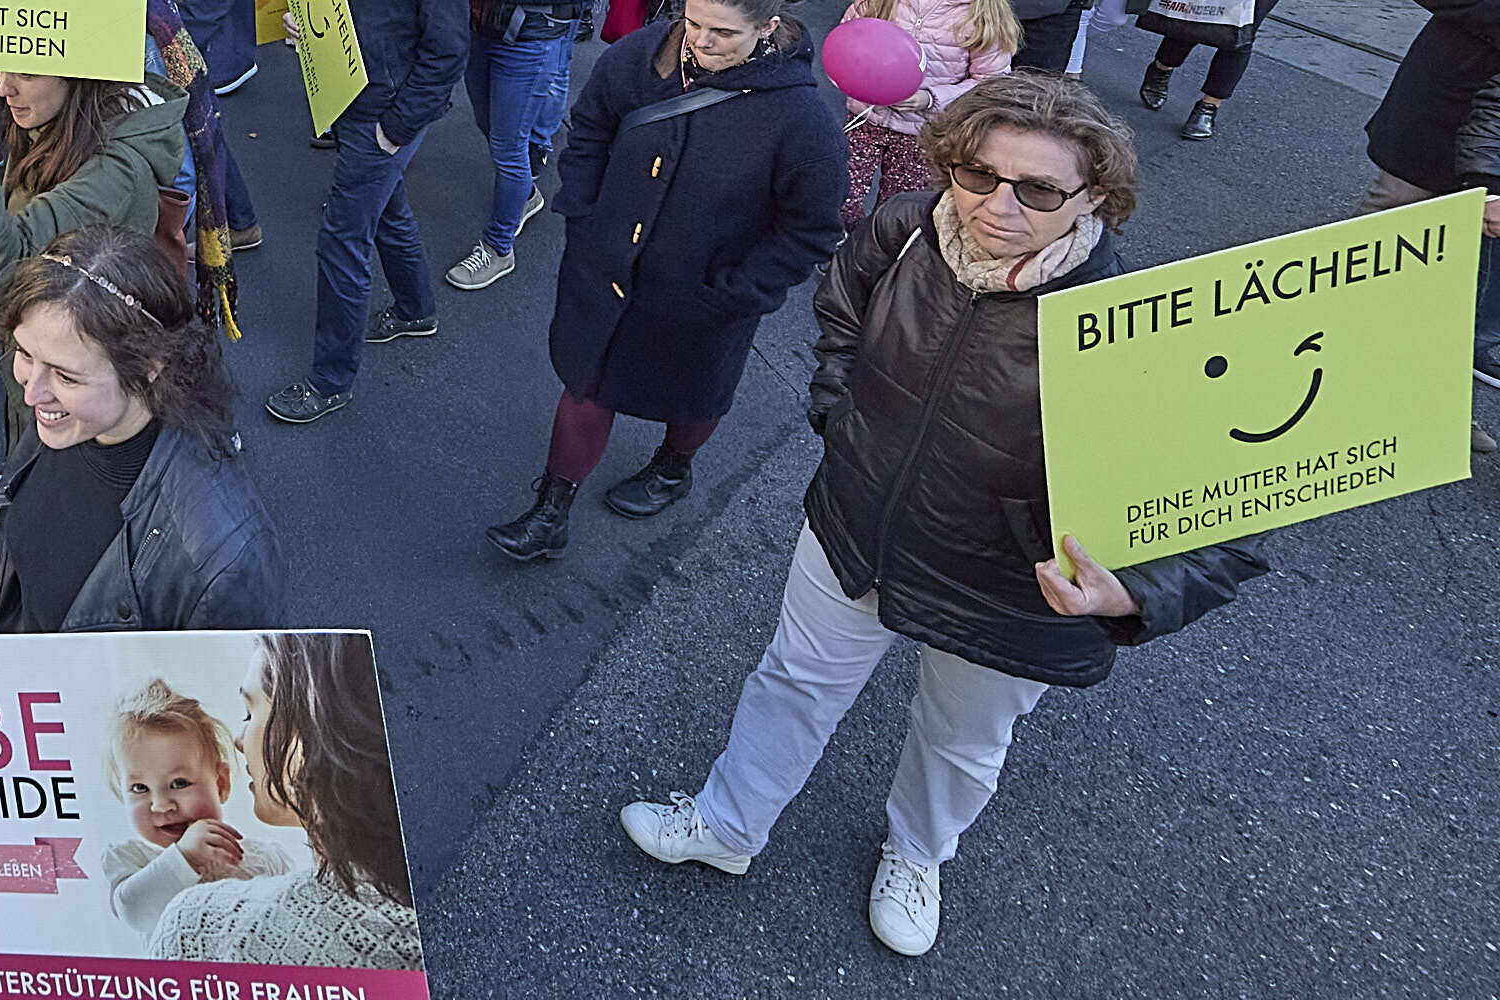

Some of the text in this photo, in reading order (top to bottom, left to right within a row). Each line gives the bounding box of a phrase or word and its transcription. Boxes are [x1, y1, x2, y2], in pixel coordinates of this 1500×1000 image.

[16, 9, 68, 30] SICH
[1077, 224, 1446, 352] BITTE LÄCHELN!
[1126, 436, 1398, 523] DEINE MUTTER HAT SICH
[1129, 462, 1396, 549] FÜR DICH ENTSCHIEDEN
[189, 973, 242, 1000] FÜR
[251, 982, 367, 1000] FRAUEN
